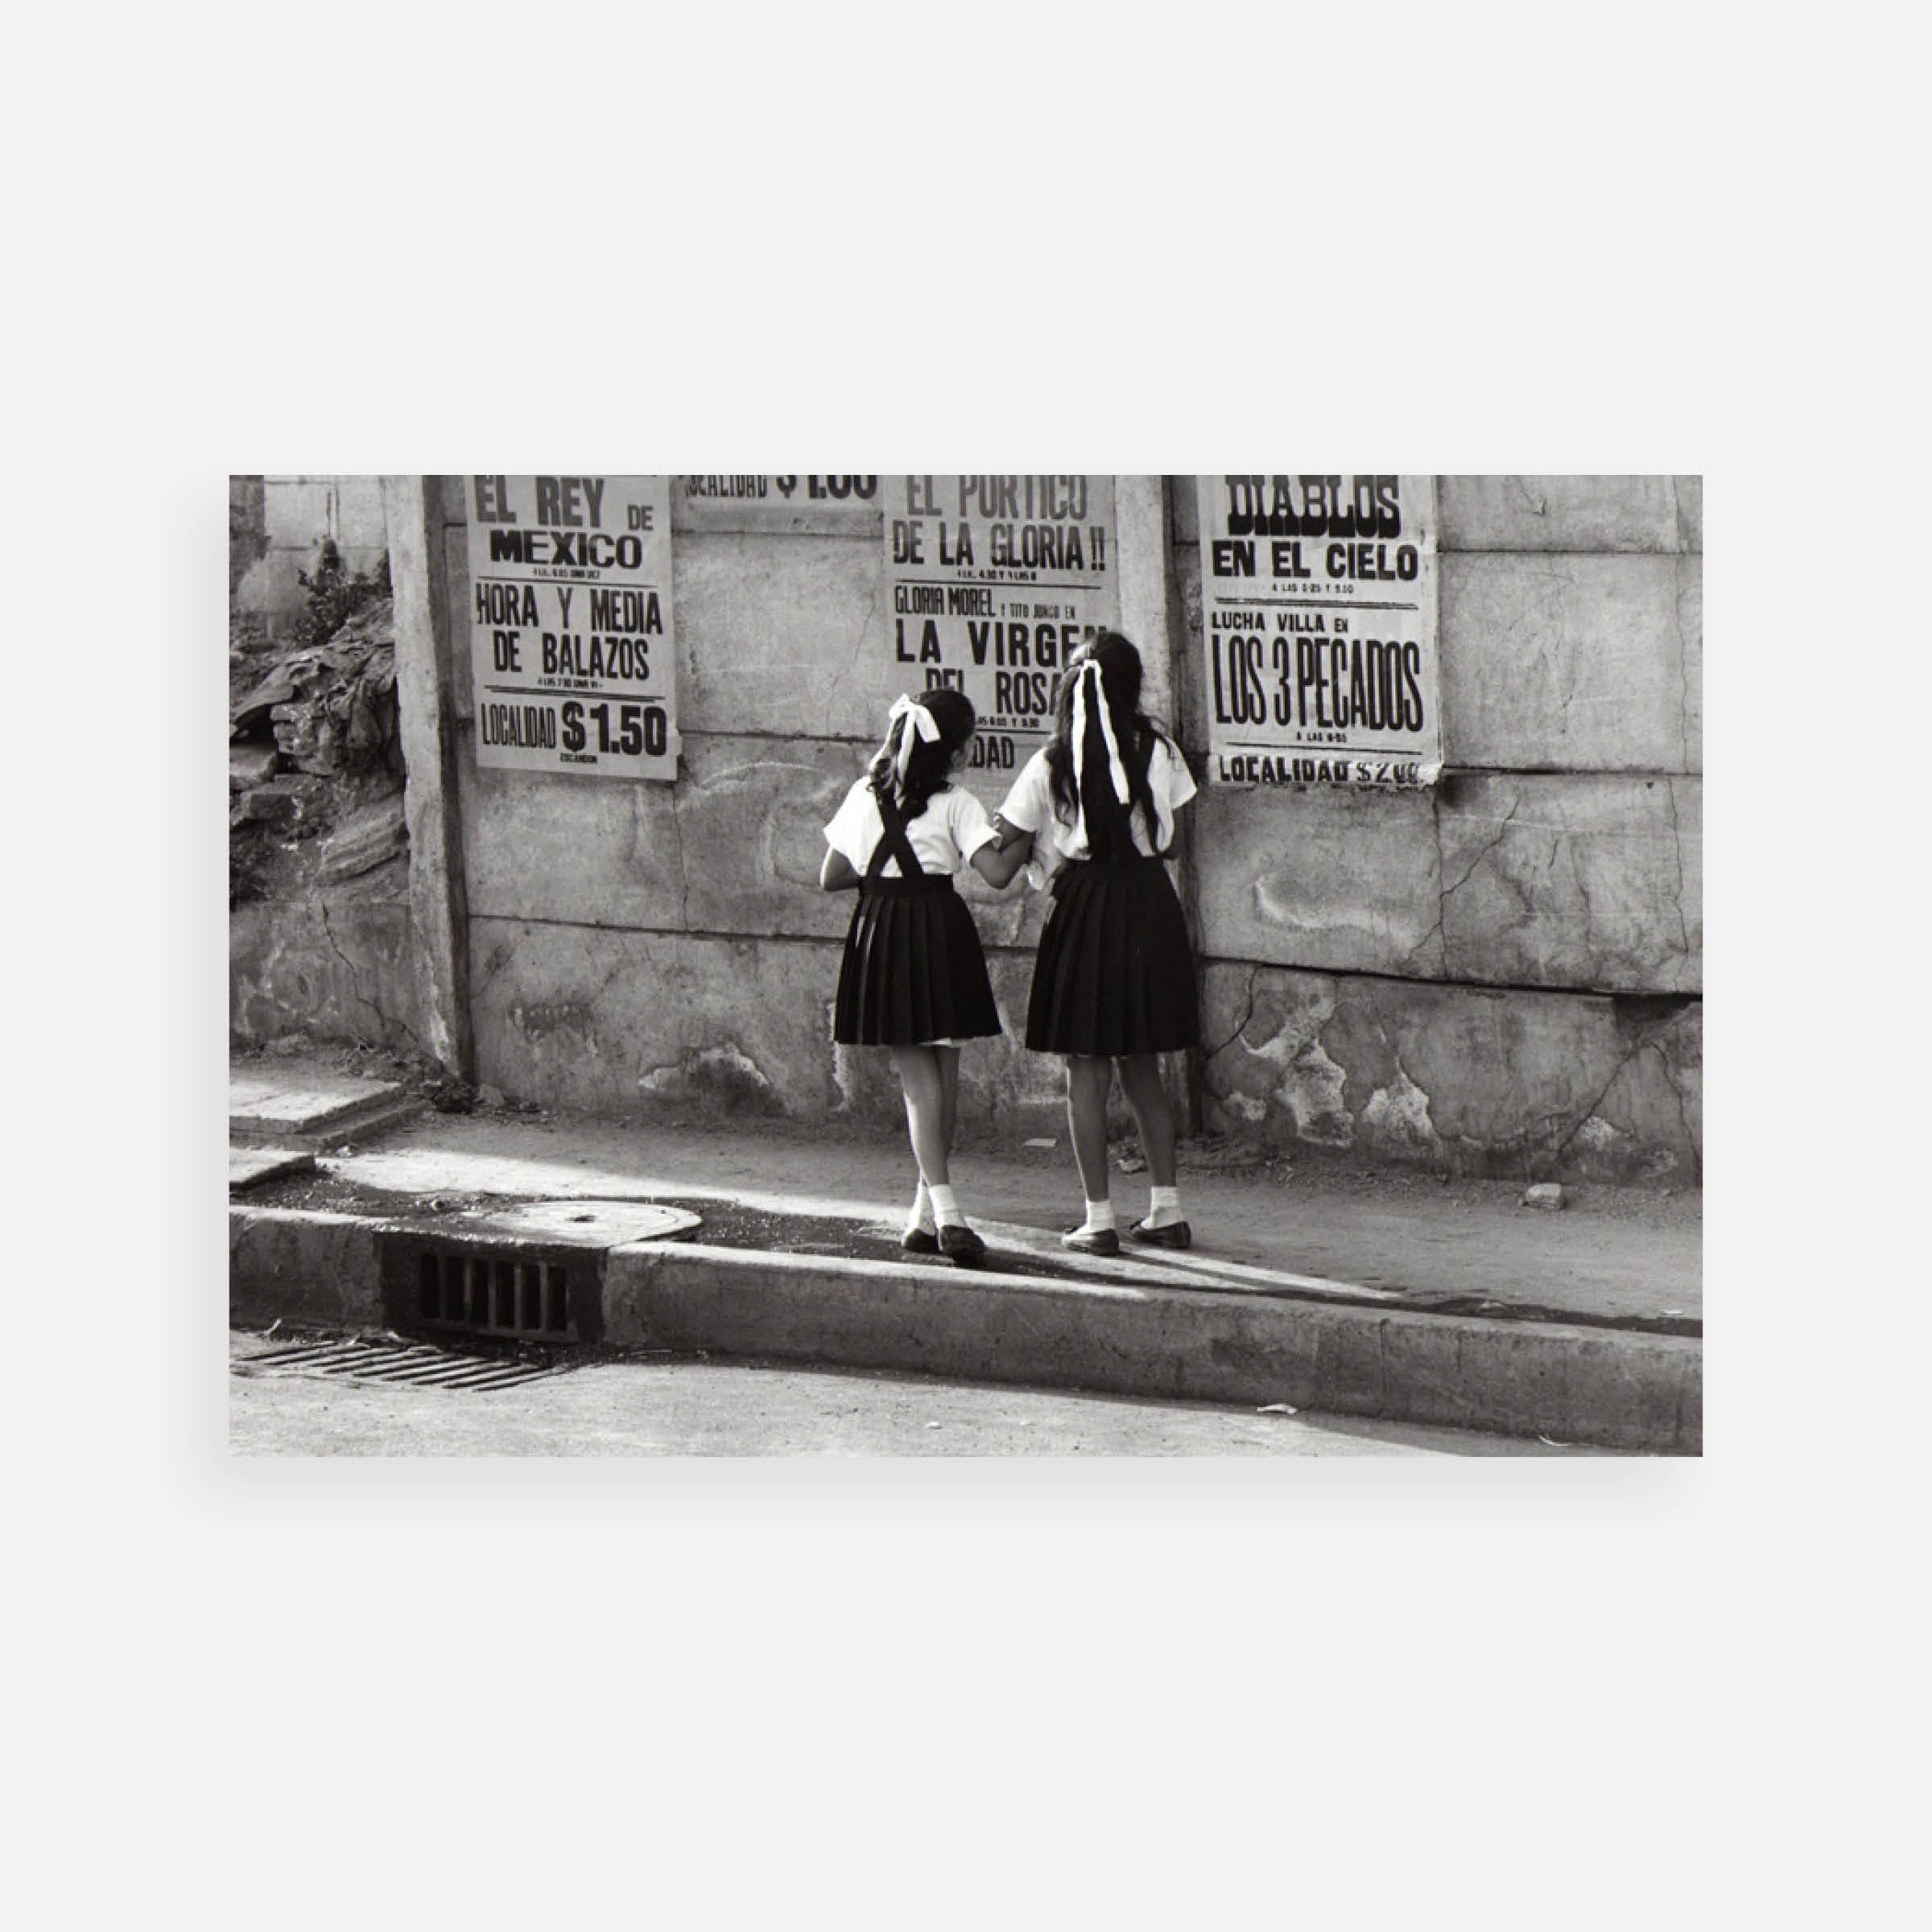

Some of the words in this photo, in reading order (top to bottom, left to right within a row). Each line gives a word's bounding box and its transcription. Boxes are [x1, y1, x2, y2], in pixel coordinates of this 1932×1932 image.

[474, 475, 517, 523] EL
[535, 476, 605, 528] REY
[627, 504, 654, 530] DE
[906, 475, 942, 516] EL
[959, 475, 1087, 520] PORTICO
[1225, 475, 1401, 539] DIABLOS
[489, 530, 642, 569] MEXICO
[893, 520, 925, 564] DE
[939, 522, 974, 565] LA
[1212, 540, 1256, 577] EN
[1272, 541, 1311, 578] EL
[1326, 543, 1418, 580] CIELO
[476, 583, 539, 626] HORA
[557, 586, 573, 629] Y
[590, 588, 663, 634] MEDIA
[894, 585, 944, 615] GLORIA
[947, 587, 996, 617] MOREL
[1212, 612, 1265, 631] LUCHA
[1277, 613, 1325, 632] VILLA
[1334, 618, 1348, 632] EN
[493, 630, 522, 673] DE
[542, 632, 650, 680] BALAZOS
[895, 618, 941, 663] LA
[968, 621, 1107, 667] VIRGE
[1212, 635, 1267, 724] LOS
[1273, 637, 1291, 726] 3
[1296, 637, 1424, 733] PECADOS
[481, 703, 556, 749] LOCALIDAD
